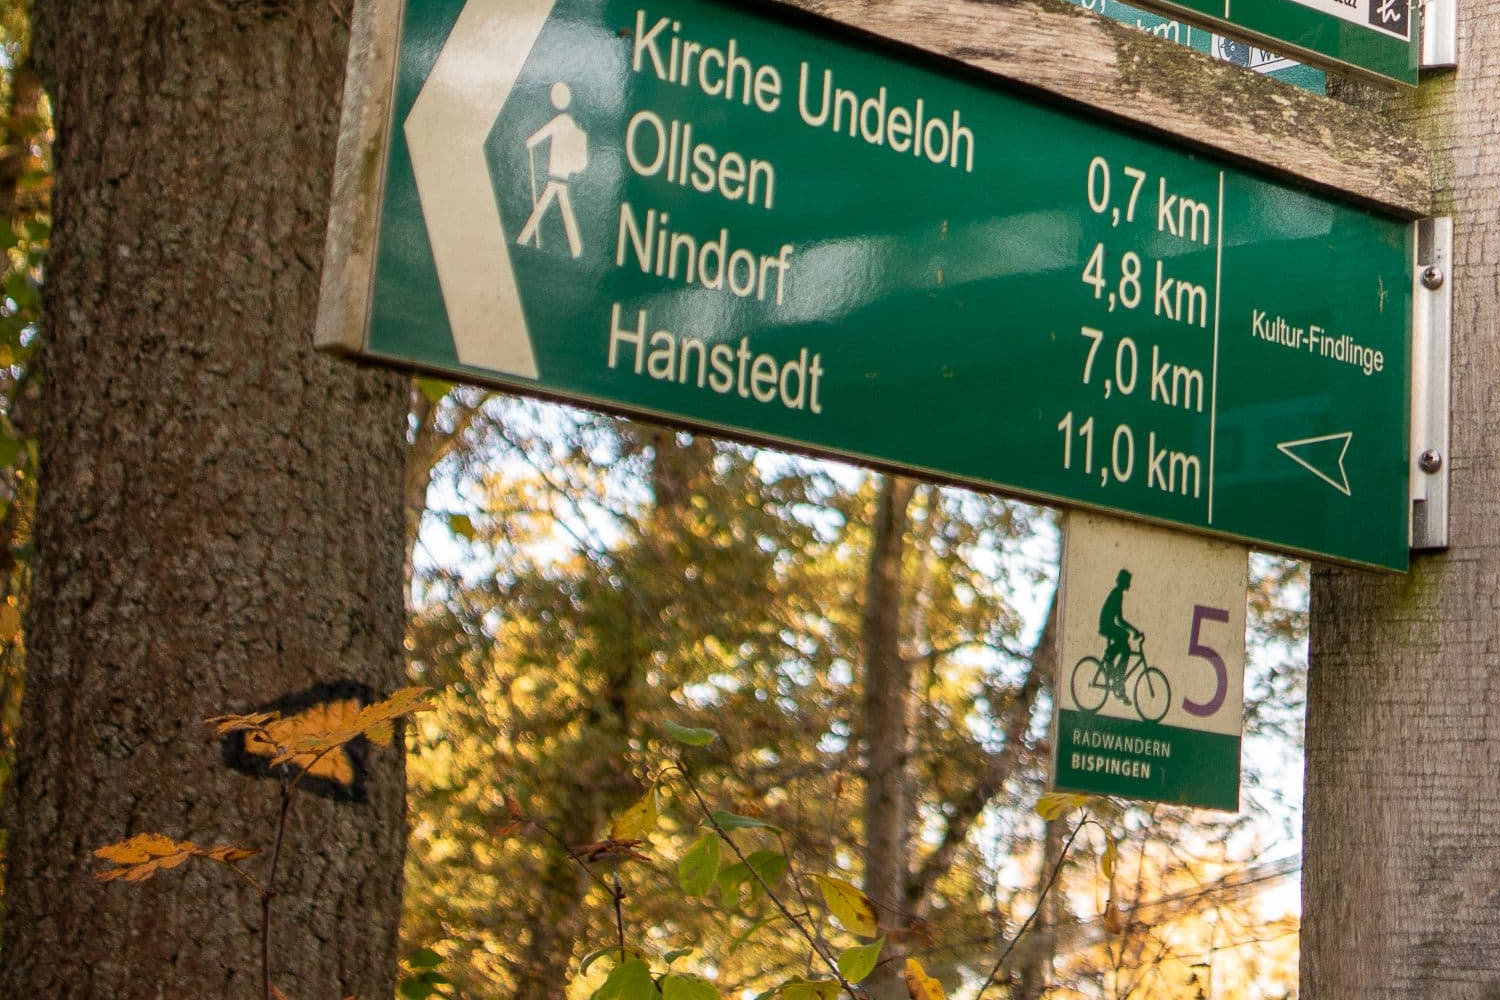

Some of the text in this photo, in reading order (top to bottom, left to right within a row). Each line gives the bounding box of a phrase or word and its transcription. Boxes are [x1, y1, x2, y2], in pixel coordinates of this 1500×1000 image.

[632, 9, 1211, 245] Kirche Undeloh 0,7 km
[625, 111, 1207, 328] Ollsen 4,8 km
[616, 203, 1204, 412] Nindorf 7,0 km
[1251, 309, 1384, 375] Kultur-Findlinge
[607, 303, 1200, 499] Hanstedt 11,0 km
[1181, 604, 1229, 717] 5
[1071, 752, 1150, 780] BISPINGEN
[1072, 728, 1171, 758] RADWANDERN
